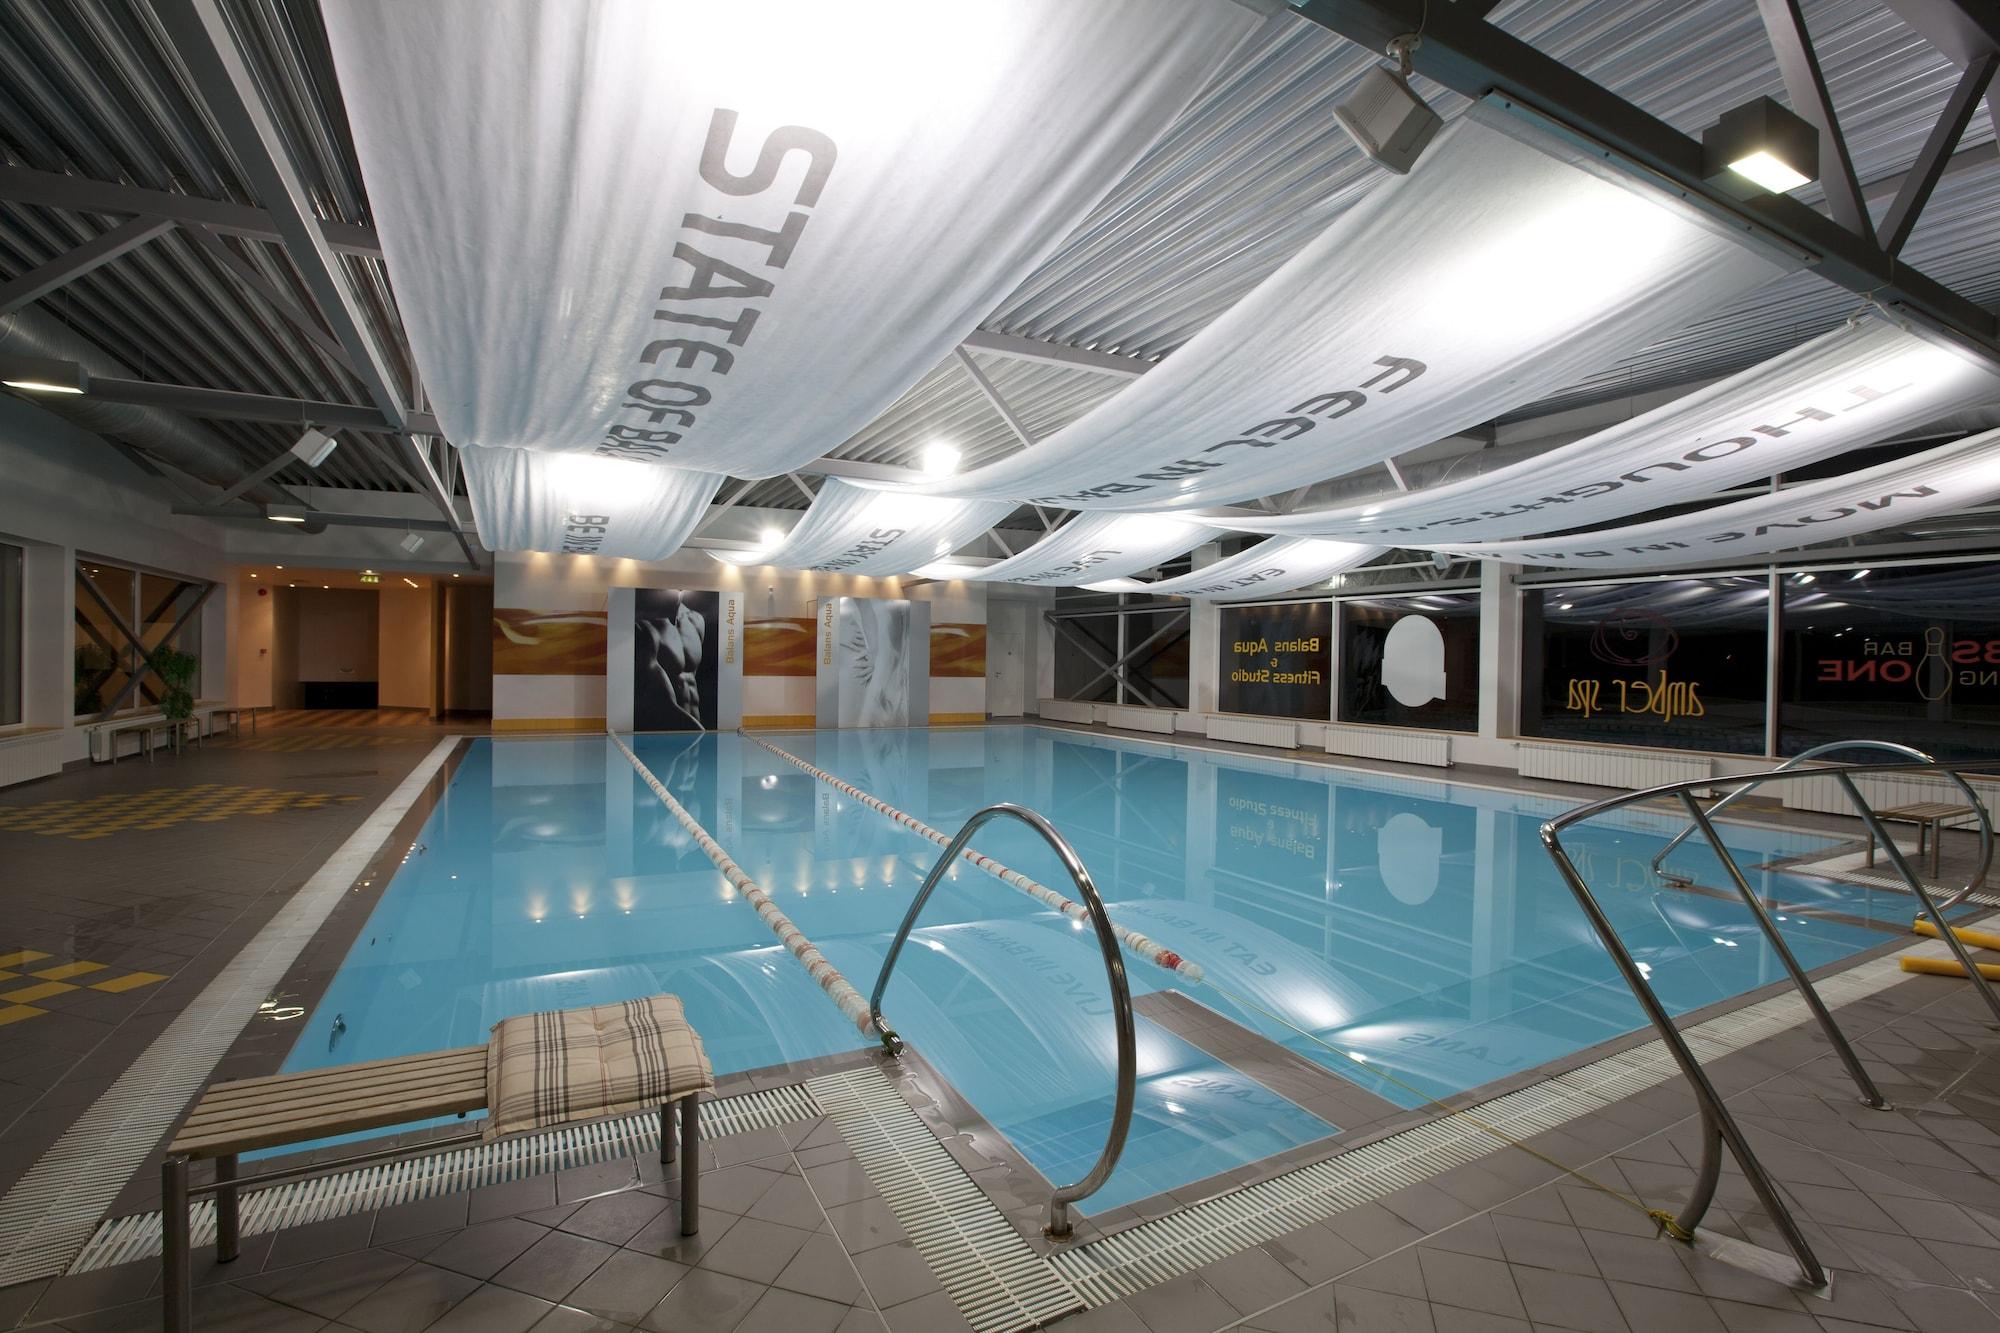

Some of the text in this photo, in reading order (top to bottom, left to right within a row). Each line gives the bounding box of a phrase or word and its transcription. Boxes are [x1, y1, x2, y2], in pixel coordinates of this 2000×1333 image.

[640, 107, 838, 376] STATE
[621, 379, 712, 428] OF
[1201, 355, 1428, 452] FEEL
[1136, 460, 1225, 482] IN
[567, 515, 610, 533] BE
[1706, 484, 1940, 543] MOVE
[842, 528, 906, 559] STAY
[1229, 568, 1287, 587] EAT
[725, 599, 737, 664] Balans Aqua
[823, 602, 834, 665] Balans Aqua
